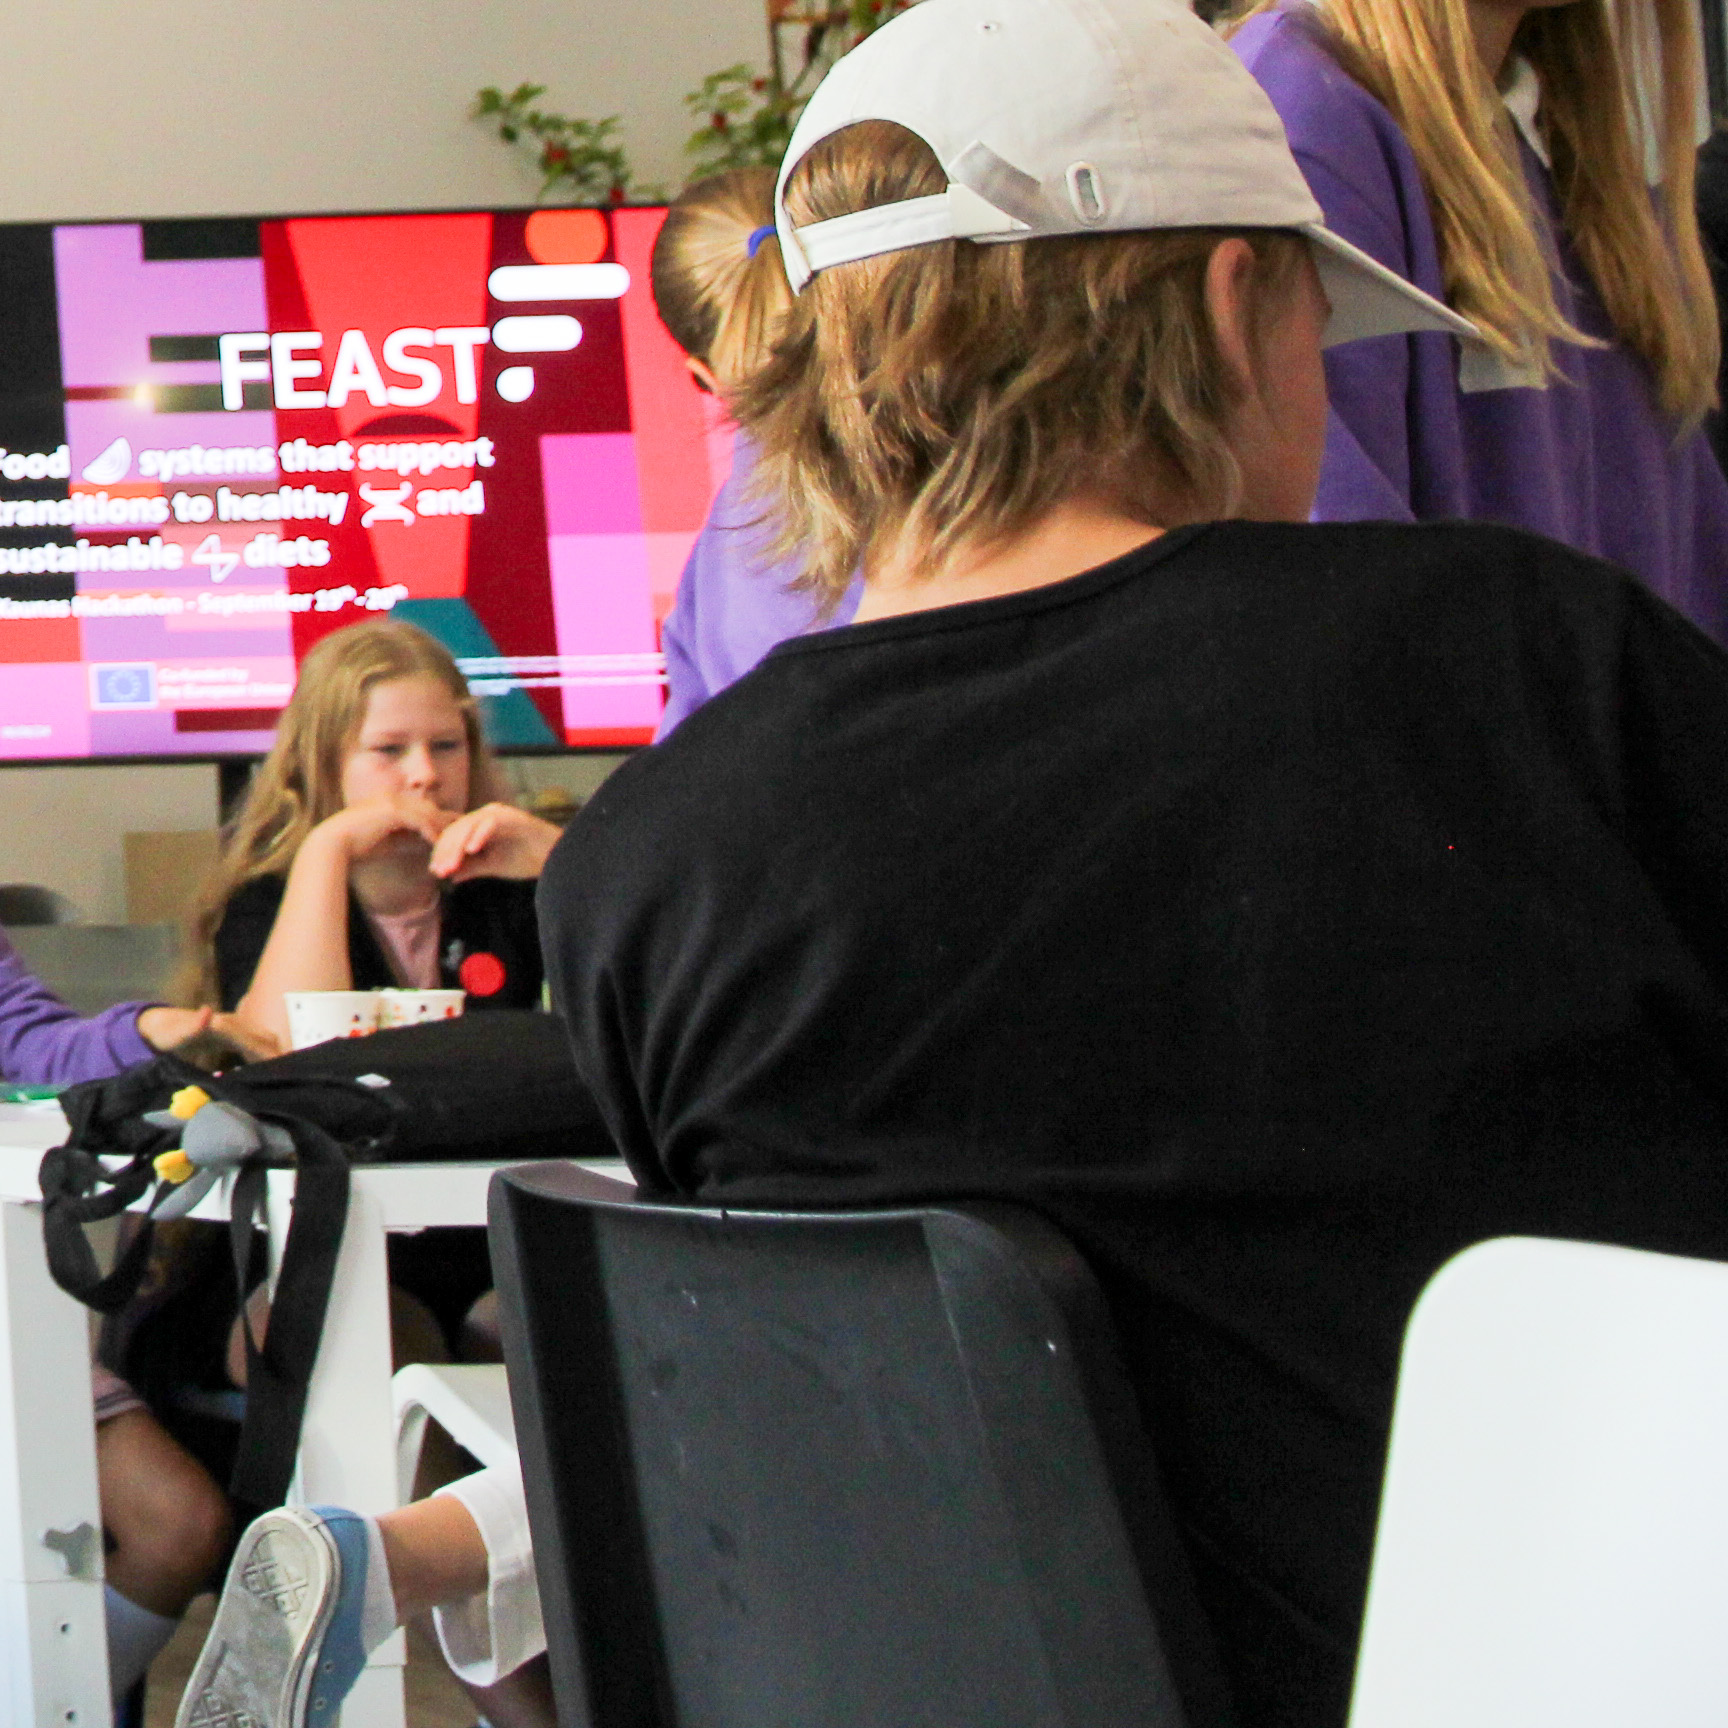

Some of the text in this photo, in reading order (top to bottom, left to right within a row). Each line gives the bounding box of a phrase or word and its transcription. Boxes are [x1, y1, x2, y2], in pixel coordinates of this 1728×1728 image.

[219, 327, 491, 411] FEAST
[138, 443, 277, 482] systems
[279, 438, 354, 473] that
[358, 436, 496, 476] support
[171, 492, 215, 524] to
[216, 484, 350, 526] healthy
[415, 480, 486, 516] and
[243, 533, 332, 569] diets
[197, 588, 313, 616] September
